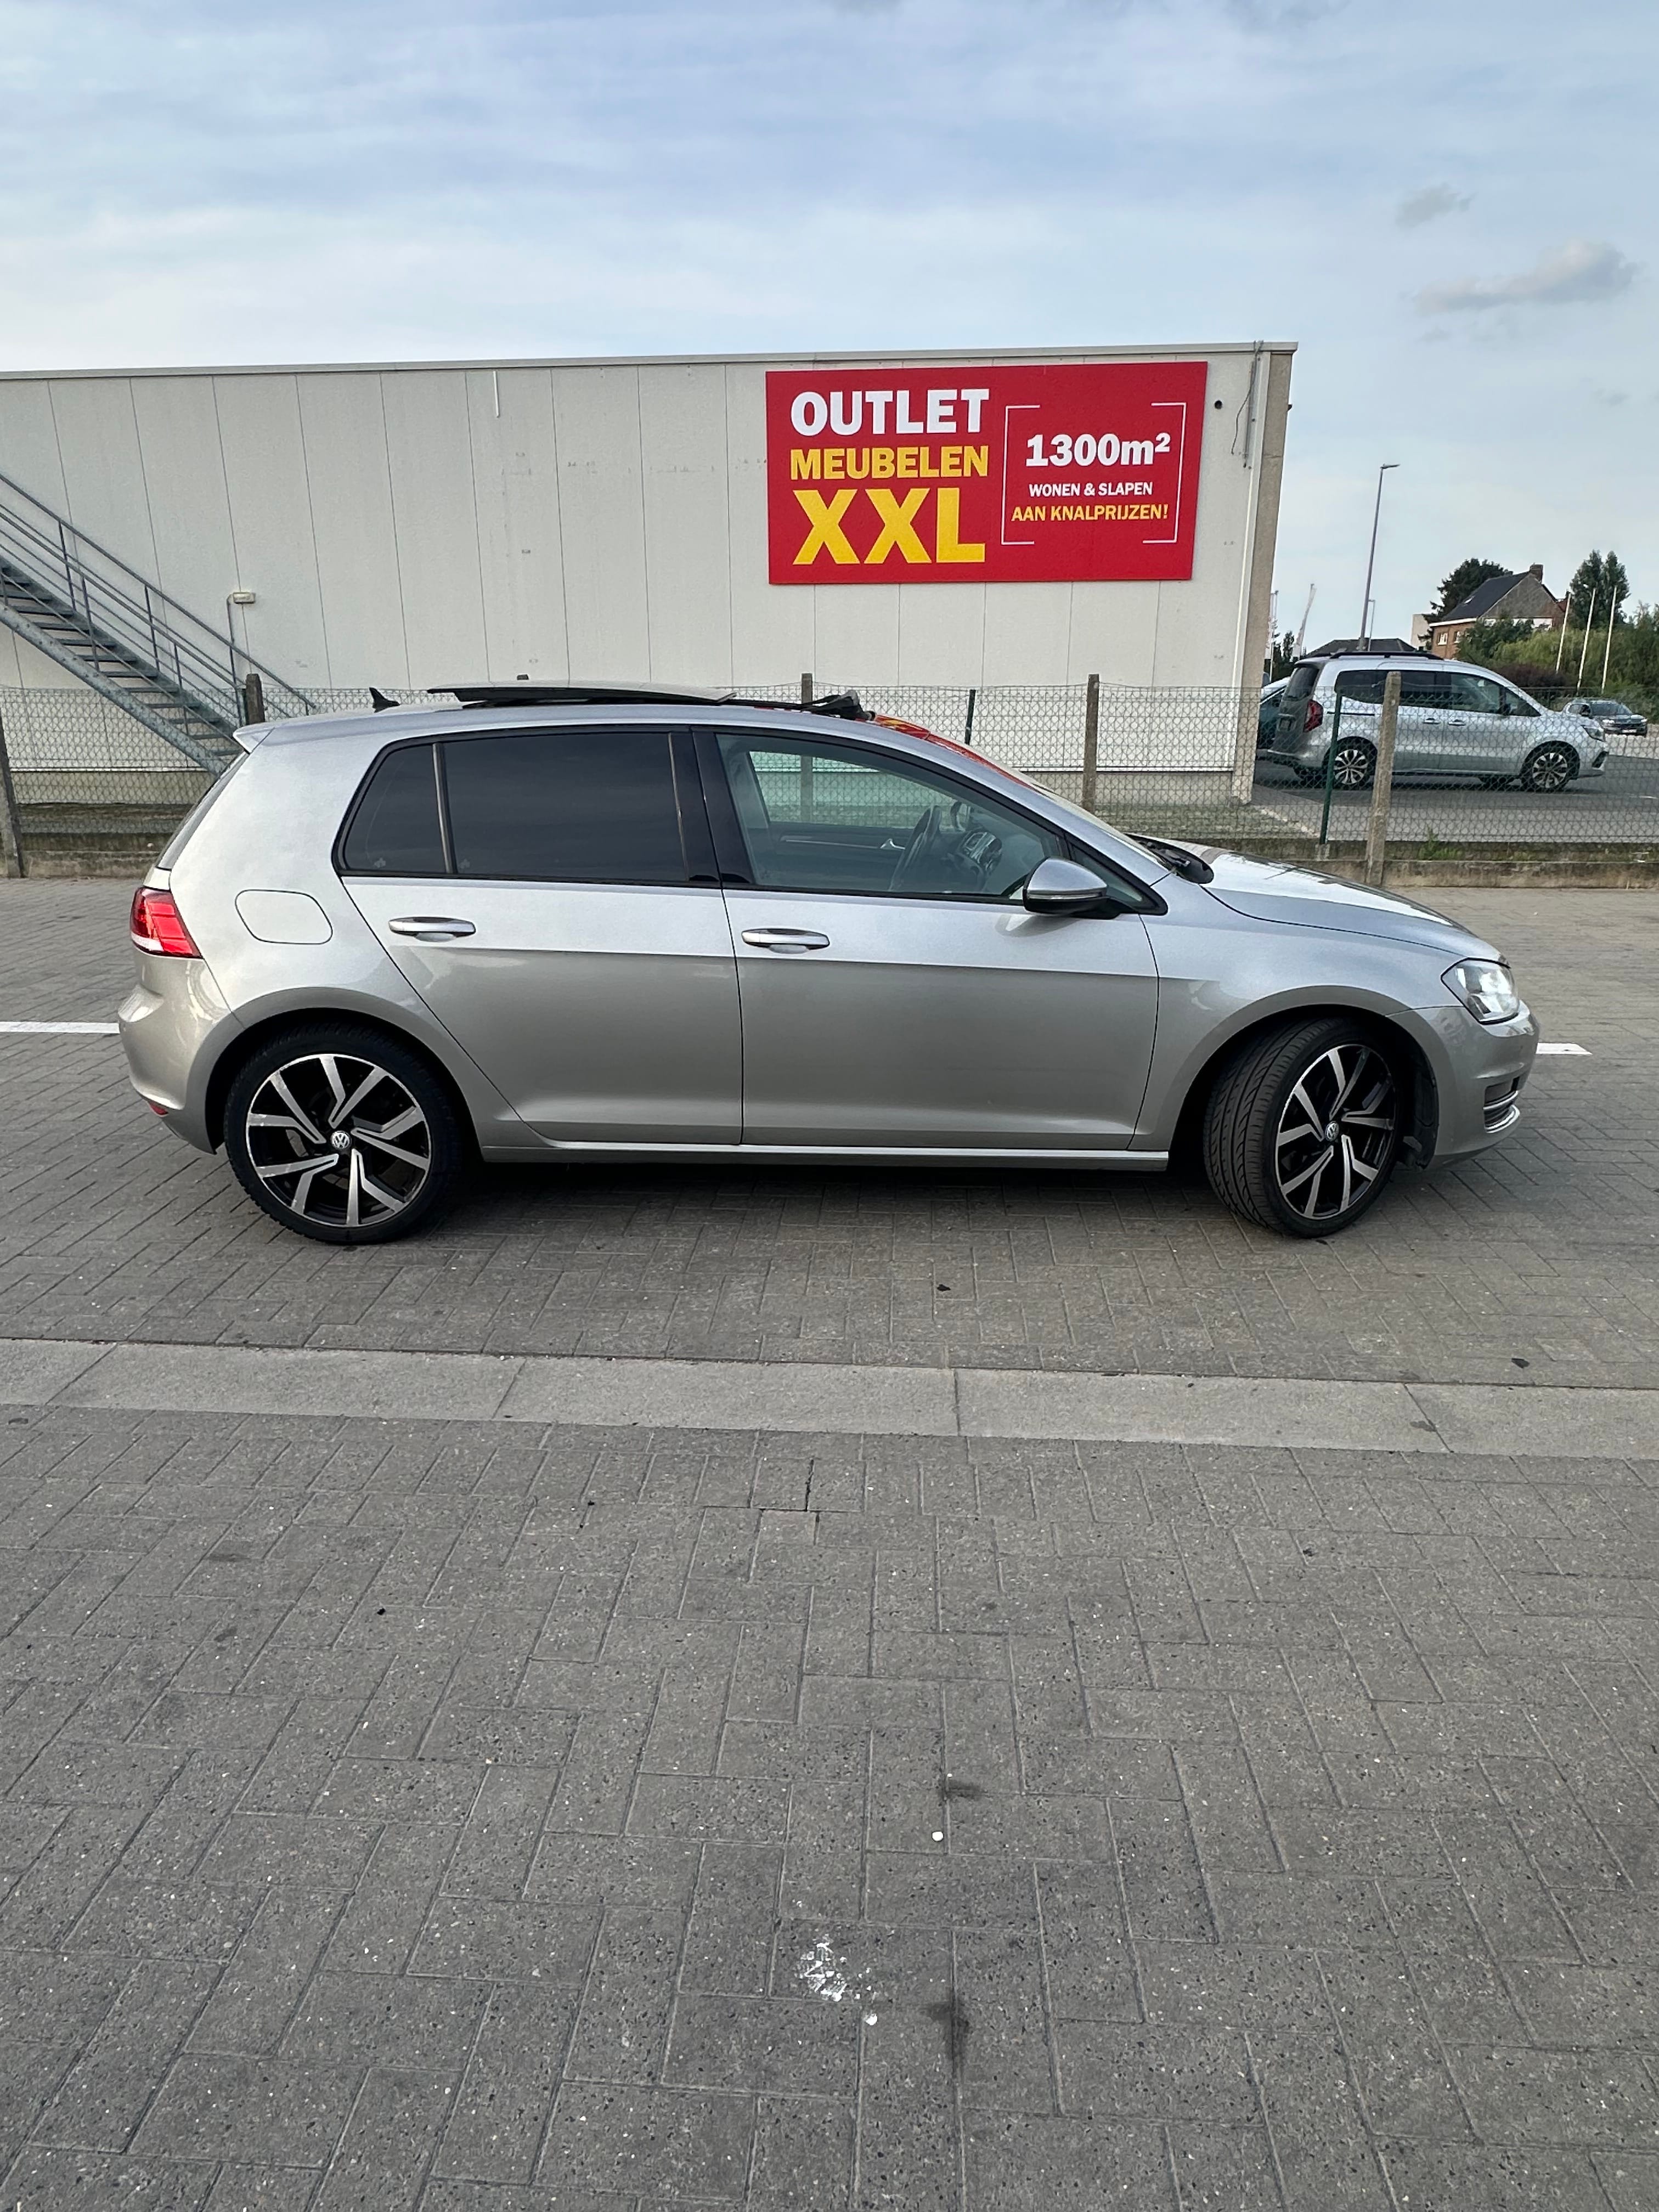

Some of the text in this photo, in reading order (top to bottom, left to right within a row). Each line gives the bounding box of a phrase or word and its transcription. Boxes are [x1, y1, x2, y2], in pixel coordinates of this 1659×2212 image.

[790, 388, 990, 437] OUTLET
[790, 445, 989, 481] MEUBELEN
[1025, 432, 1171, 466] 1300m²
[1029, 481, 1154, 497] WONEN & SLAPEN
[792, 487, 986, 565] XXL
[1011, 504, 1169, 522] AAN KNALPRIJZEN!
